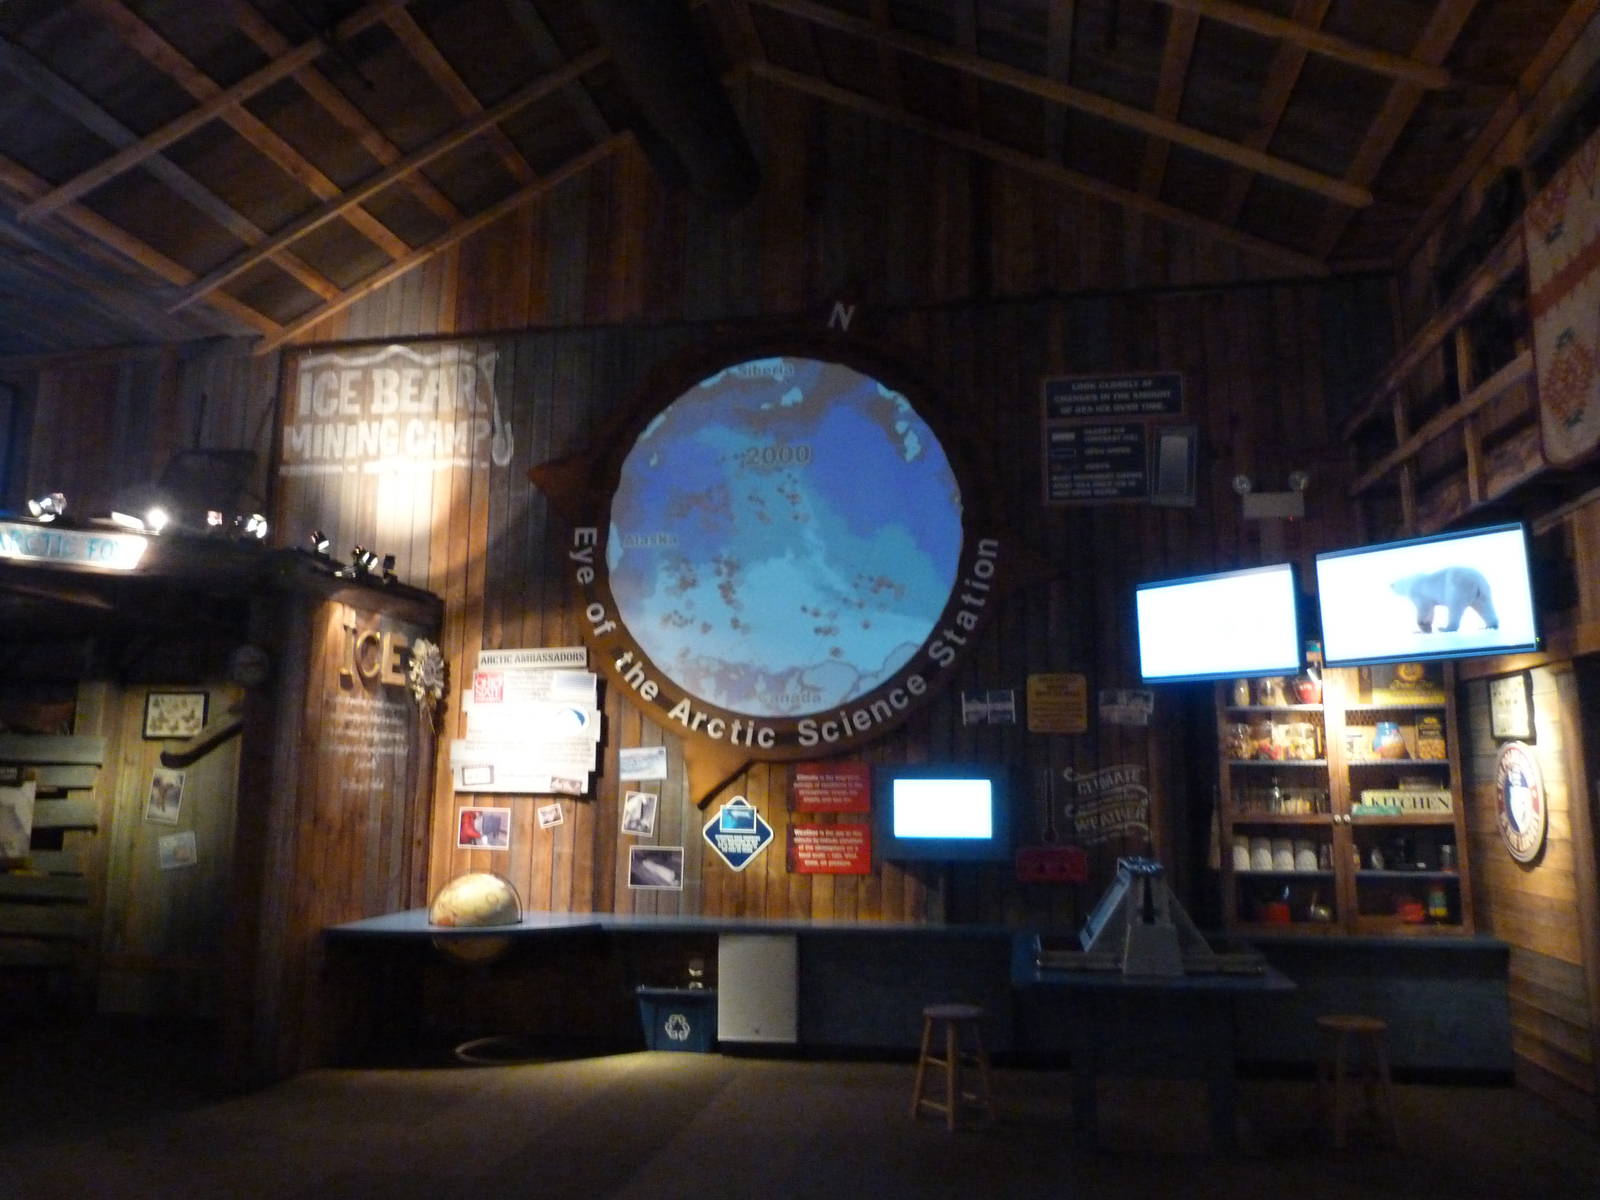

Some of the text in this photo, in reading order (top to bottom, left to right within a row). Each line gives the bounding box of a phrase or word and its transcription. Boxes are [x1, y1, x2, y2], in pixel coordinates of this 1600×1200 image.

[828, 301, 855, 332] N
[300, 364, 488, 416] ICE BEAR
[283, 420, 491, 459] MINING CAMP
[746, 445, 811, 464] 2000
[574, 527, 598, 584] Eye
[586, 602, 616, 637] of
[615, 651, 659, 701] the
[667, 698, 776, 749] Arctic
[797, 675, 927, 748] Science
[928, 538, 1000, 667] Station
[481, 651, 585, 665] ARCTIC AMBASSADORS
